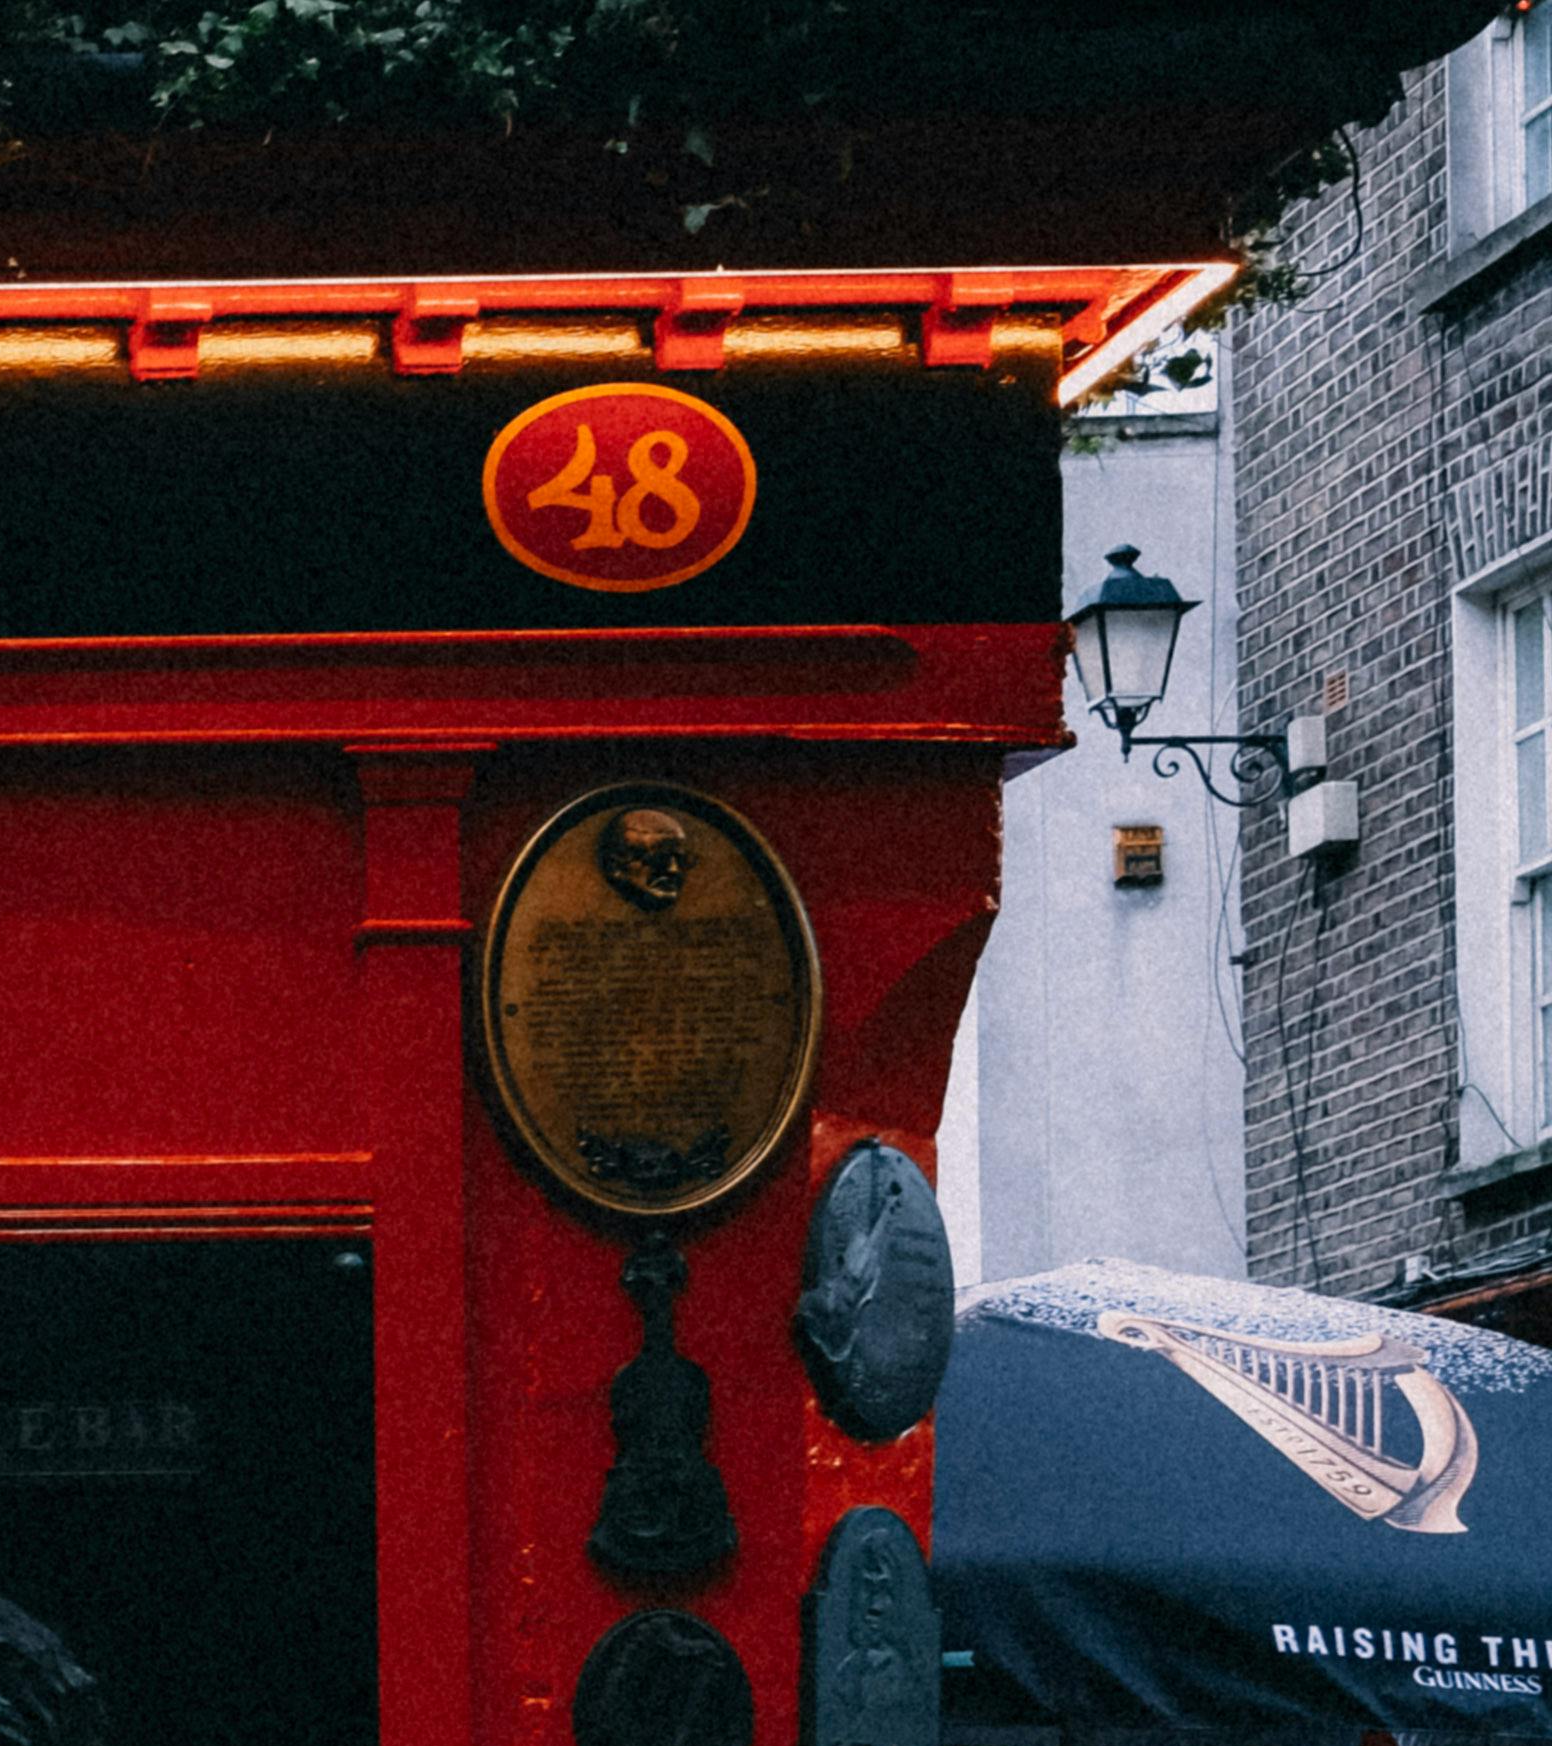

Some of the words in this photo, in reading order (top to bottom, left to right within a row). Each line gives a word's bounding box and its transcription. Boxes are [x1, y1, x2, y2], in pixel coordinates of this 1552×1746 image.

[523, 420, 692, 551] 48
[74, 1403, 199, 1449] BAR
[1297, 1449, 1372, 1495] 1759
[1272, 1624, 1457, 1665] RAISING
[1481, 1635, 1552, 1668] TH
[1413, 1666, 1543, 1694] GUINNESS
